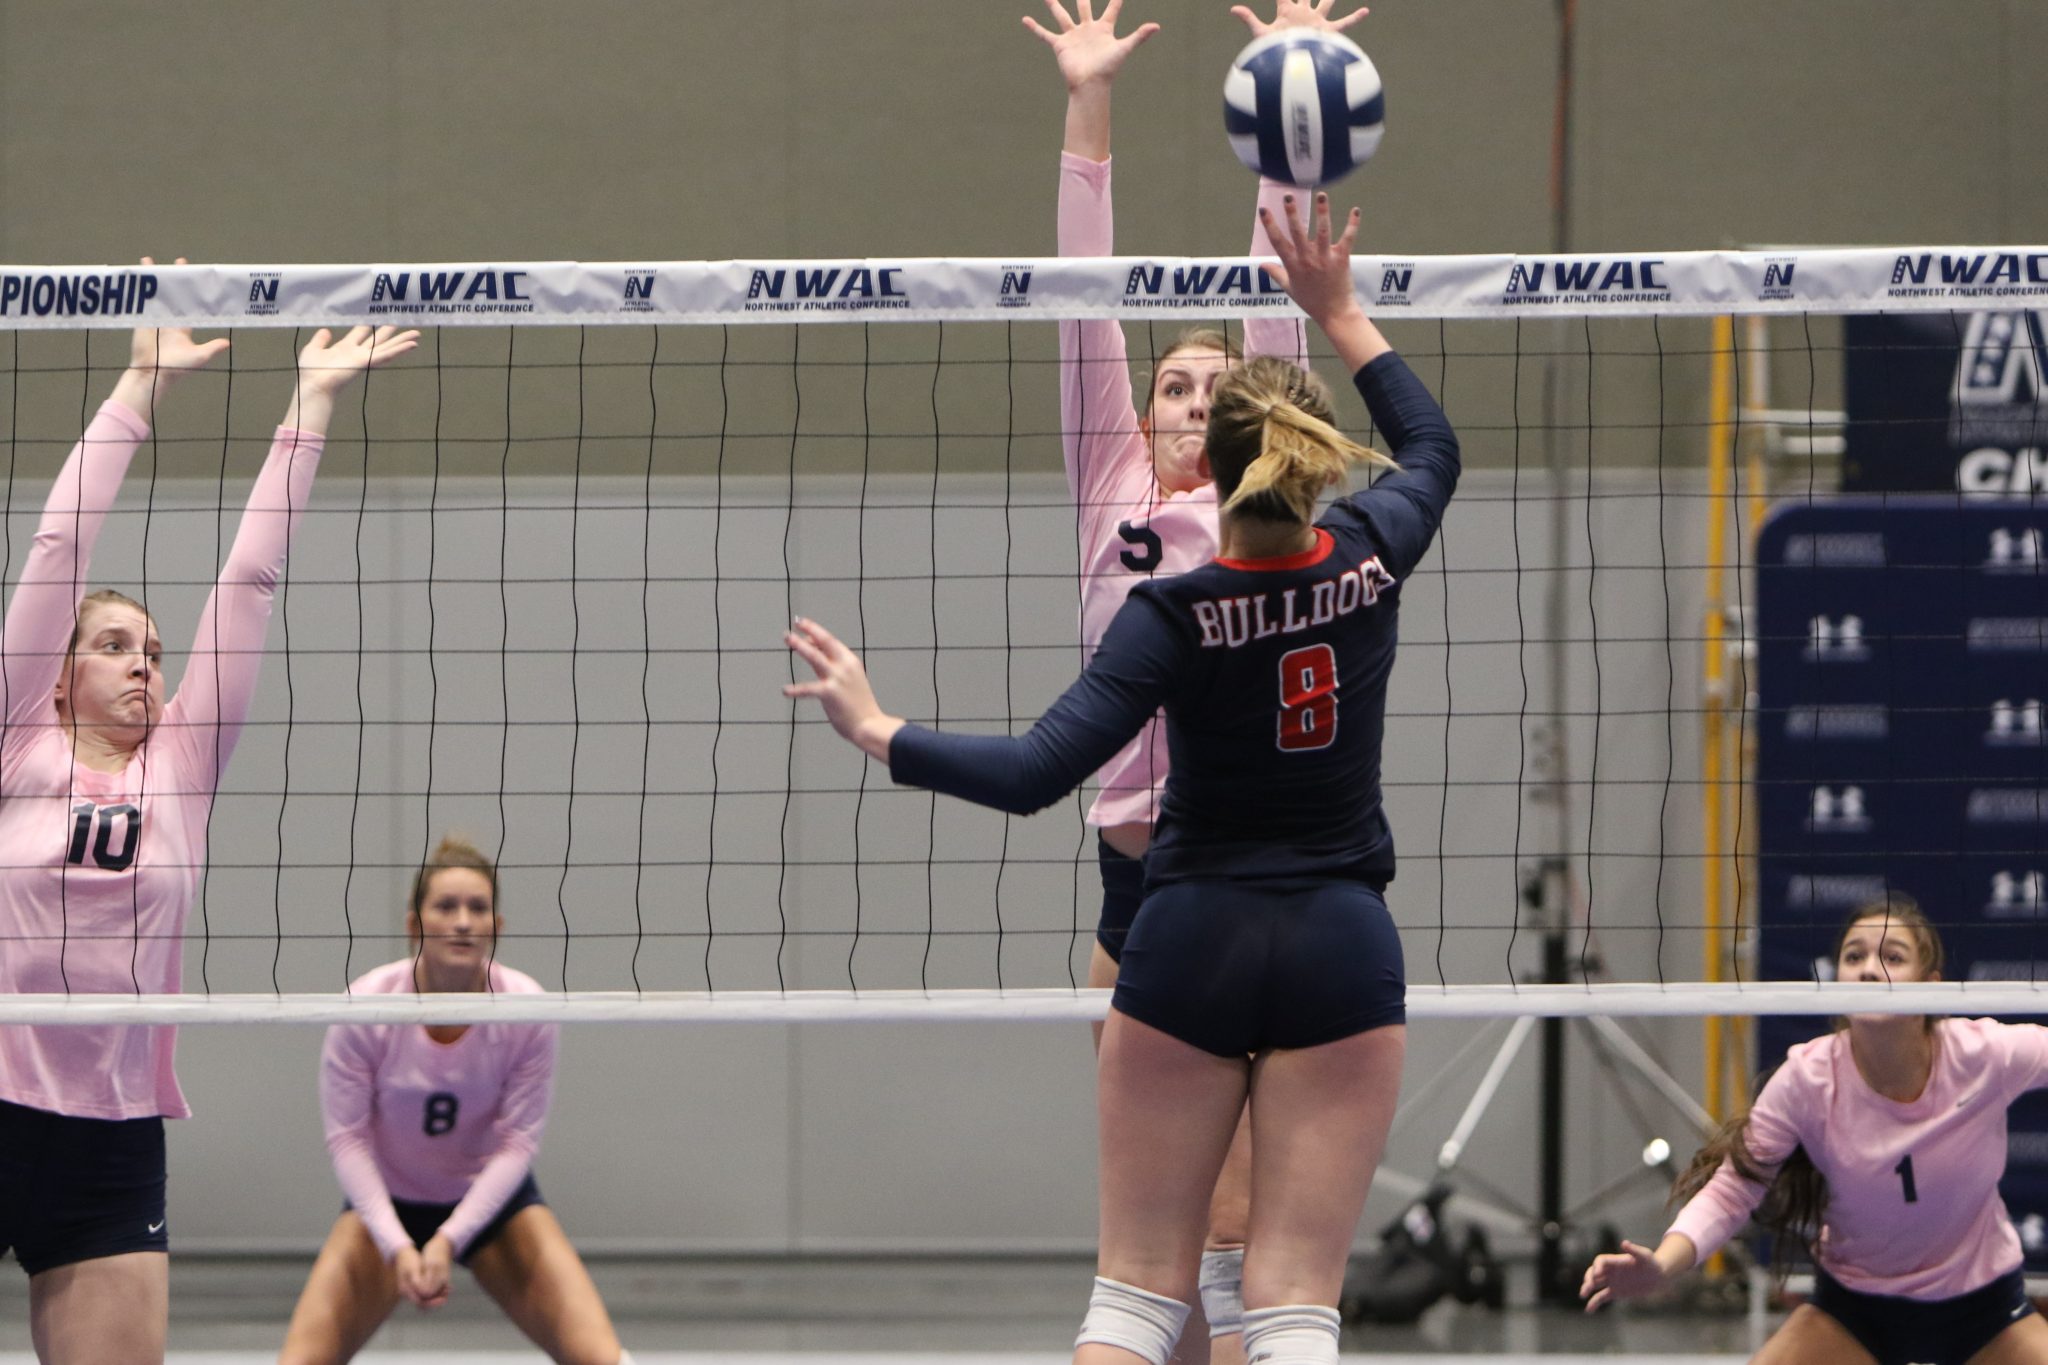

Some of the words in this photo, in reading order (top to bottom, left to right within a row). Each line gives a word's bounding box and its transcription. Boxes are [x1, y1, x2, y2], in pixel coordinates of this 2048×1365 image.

[747, 268, 906, 299] NWAC
[1505, 261, 1667, 293] NWAC
[1890, 253, 2048, 284] NWAC
[0, 274, 158, 317] PIONSHIP
[371, 271, 531, 301] NWAC
[1502, 294, 1560, 305] NORTHWEST
[1563, 293, 1608, 304] ATHLETIC
[1610, 292, 1671, 303] CONFERENCE
[1887, 287, 1945, 297] NORTHWEST
[1948, 287, 1993, 297] ATHLETIC
[369, 304, 426, 314] NORTHWEST
[428, 304, 472, 313] ATHLETIC
[474, 303, 534, 312] CONFERENCE
[744, 302, 801, 311] NORTHWEST
[803, 301, 847, 310] ATHLETIC
[850, 300, 910, 309] CONFERENCE
[1122, 298, 1180, 308] NORTHWEST
[1182, 298, 1226, 308] ATHLETIC
[1228, 297, 1289, 307] CONFERENCE
[1276, 642, 1340, 752] 8
[67, 802, 140, 873] 10
[423, 1091, 460, 1137] 8
[1894, 1154, 1918, 1204] 1
